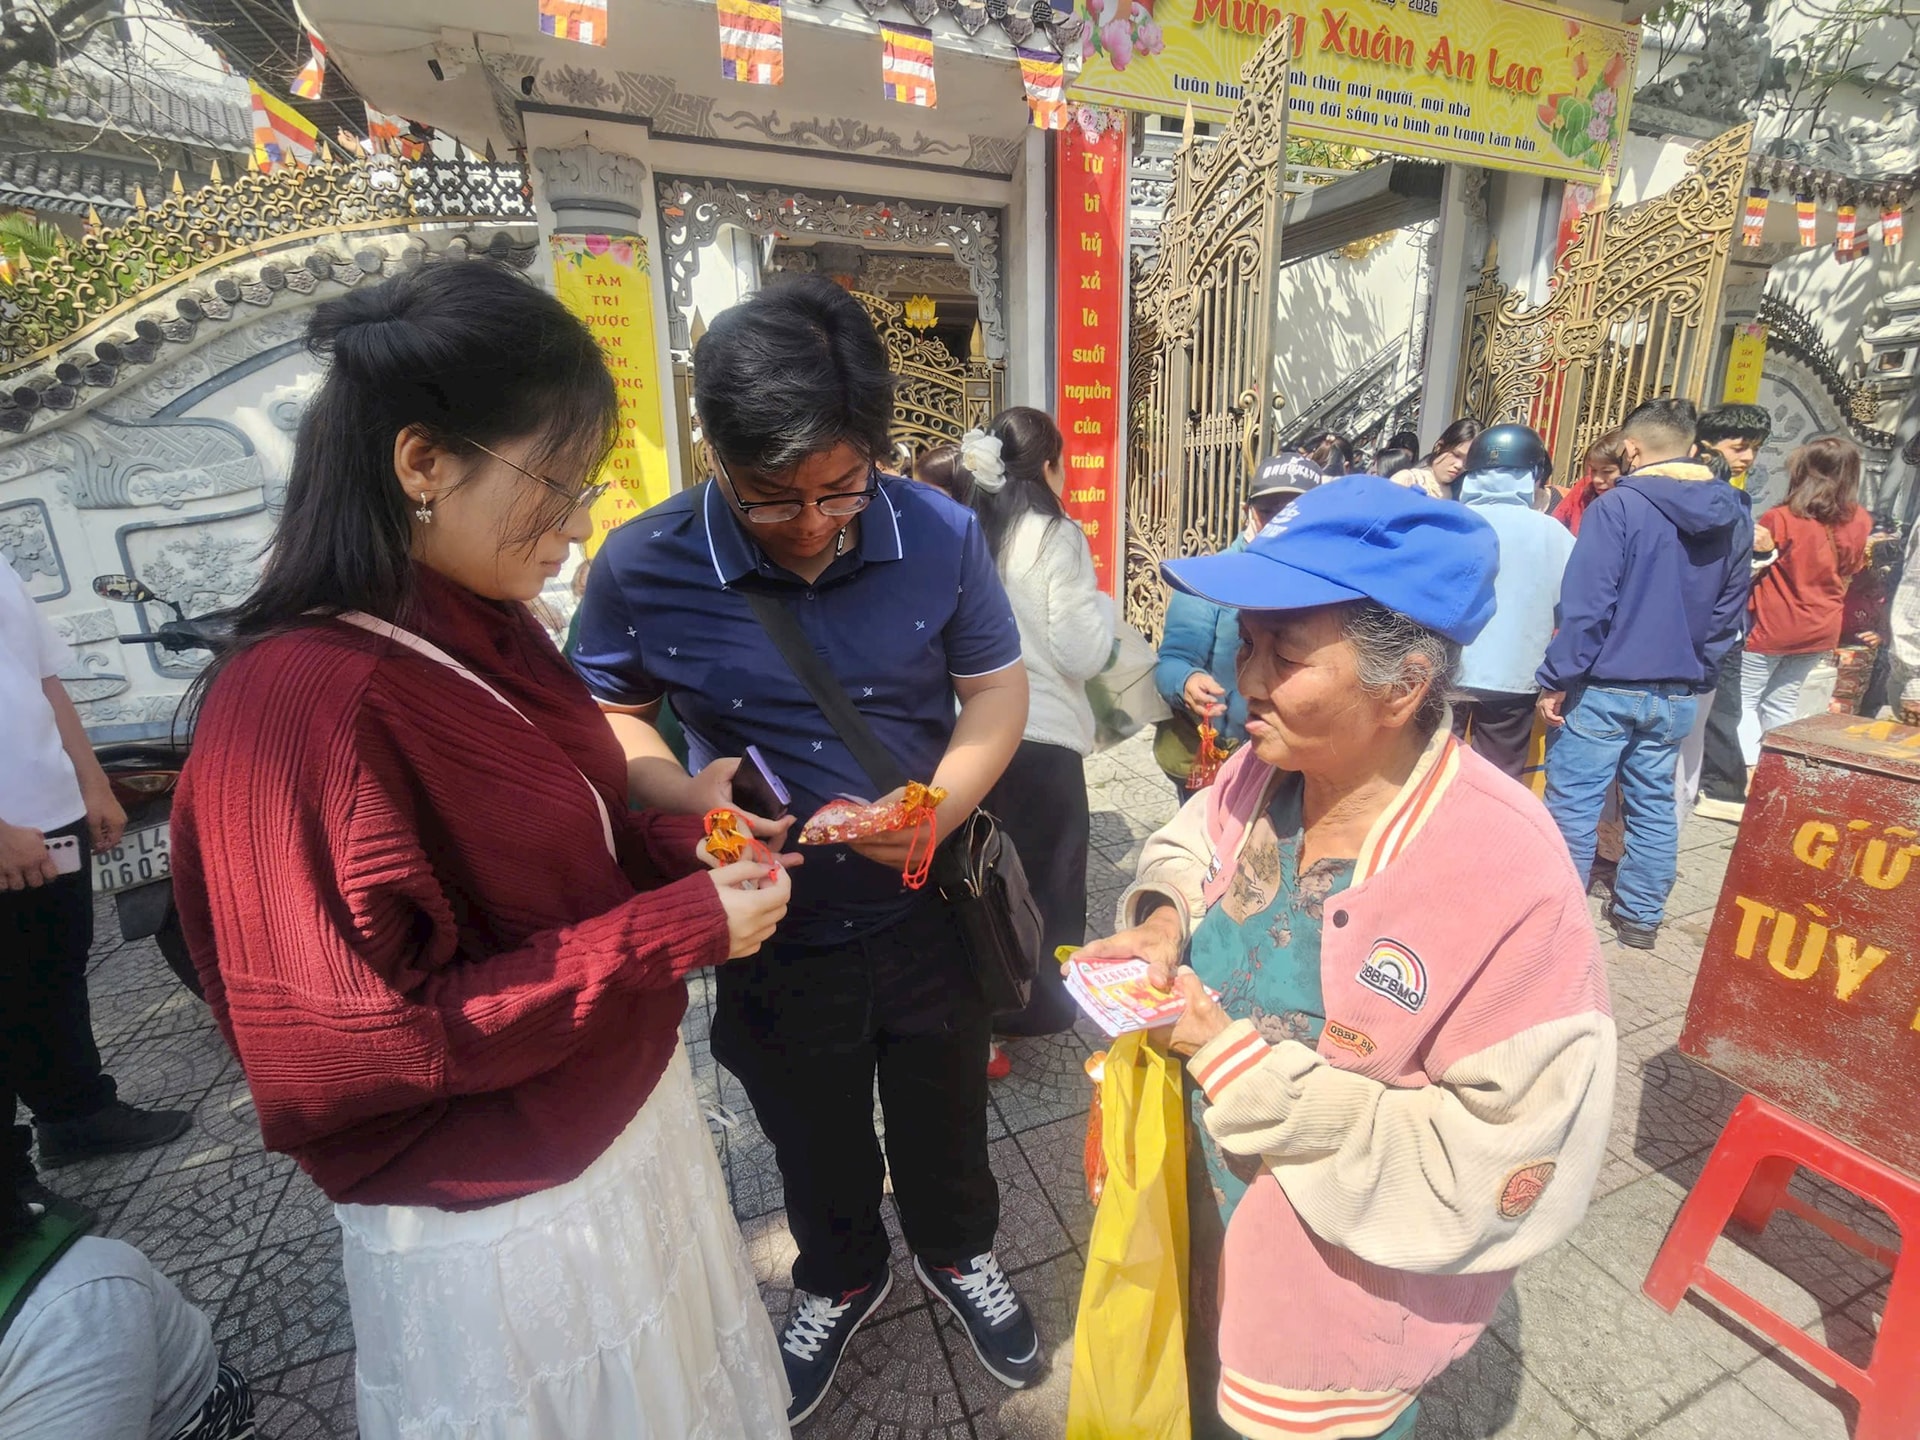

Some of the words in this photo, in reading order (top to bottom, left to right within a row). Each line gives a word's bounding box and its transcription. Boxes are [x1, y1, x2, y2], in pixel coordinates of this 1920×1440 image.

[1408, 0, 1438, 14] 2026
[1320, 8, 1415, 67] Xuân
[1425, 36, 1475, 80] An
[1488, 48, 1543, 96] Lạc
[1290, 71, 1307, 86] nh
[1313, 75, 1341, 93] chúc
[1347, 82, 1371, 99] mọi
[1421, 97, 1444, 113] mọi
[1448, 102, 1470, 117] nhà
[1289, 98, 1314, 115] ong
[1320, 101, 1341, 118] đời
[1346, 105, 1378, 126] sống
[1384, 113, 1398, 128] và
[1403, 115, 1430, 134] bình
[1435, 124, 1449, 137] an
[1453, 125, 1485, 145] trong
[1081, 152, 1104, 175] Từ
[584, 273, 622, 287] TÂM
[1080, 271, 1101, 290] xả
[585, 314, 630, 328] ĐƯỢC
[1082, 308, 1098, 327] là
[1072, 344, 1105, 363] suối
[1065, 379, 1112, 405] nguồn
[1074, 416, 1101, 435] của
[1071, 453, 1105, 469] mùa
[615, 499, 637, 509] TA
[1070, 486, 1106, 503] xuân
[1082, 519, 1099, 539] uệ
[1735, 895, 1891, 1001] TÙY
